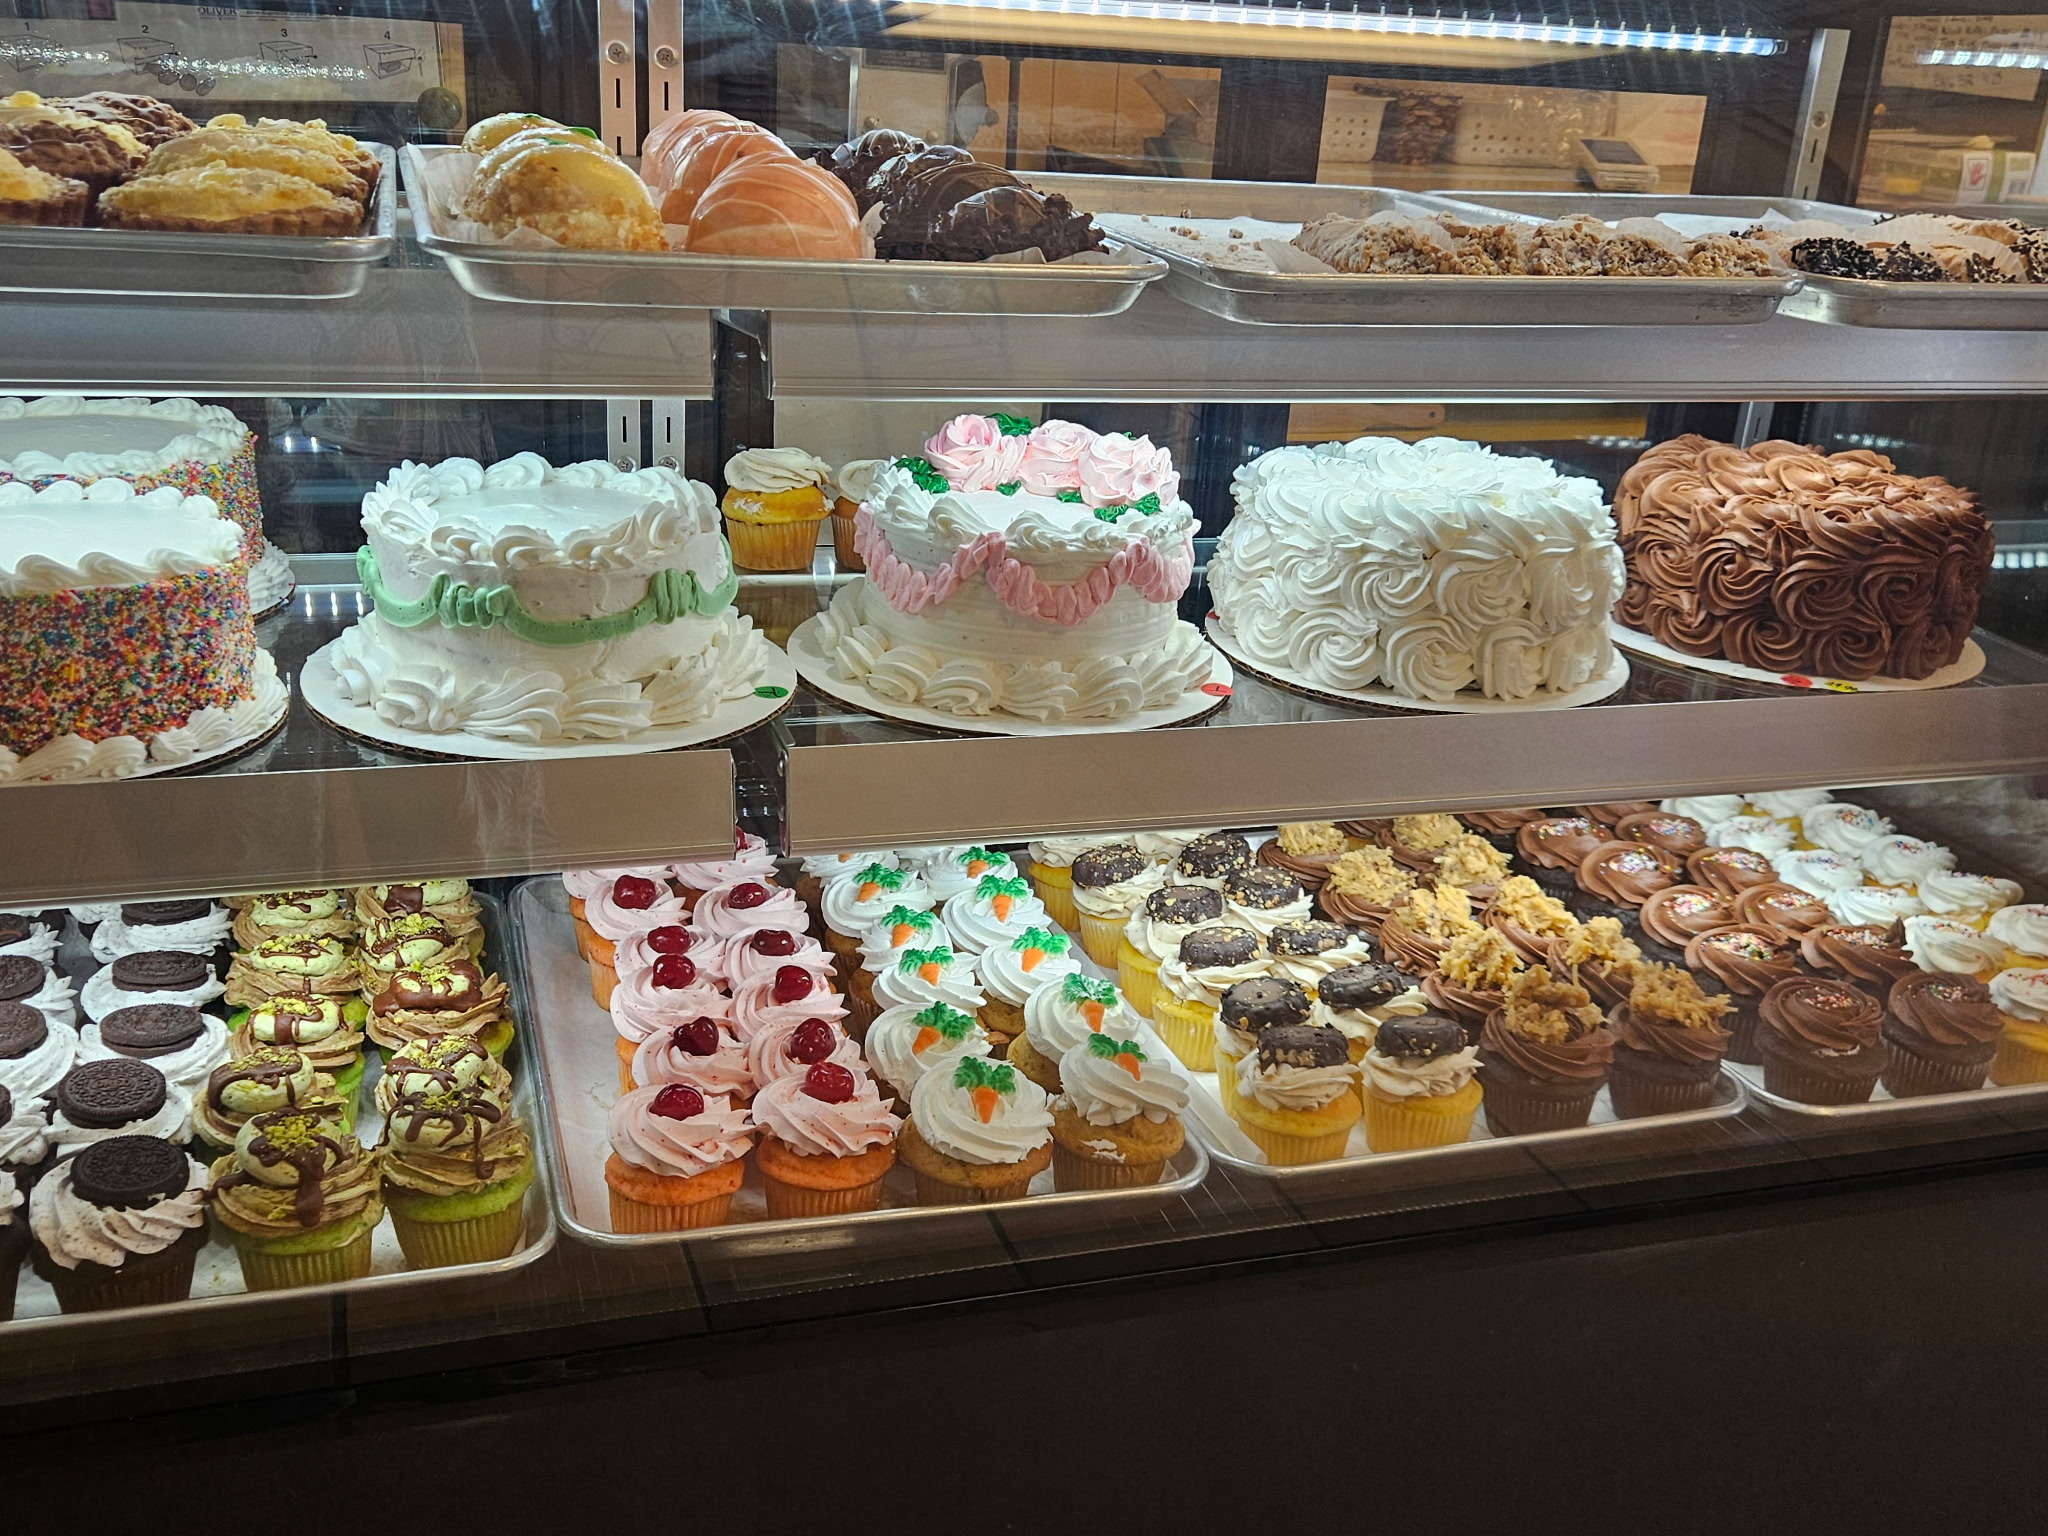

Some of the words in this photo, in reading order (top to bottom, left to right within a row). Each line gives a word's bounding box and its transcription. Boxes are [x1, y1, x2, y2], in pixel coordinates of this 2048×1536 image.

[197, 6, 237, 16] OLIVER
[23, 21, 30, 31] 1
[141, 24, 150, 34] 2
[280, 28, 288, 38] 3
[383, 30, 391, 41] 4
